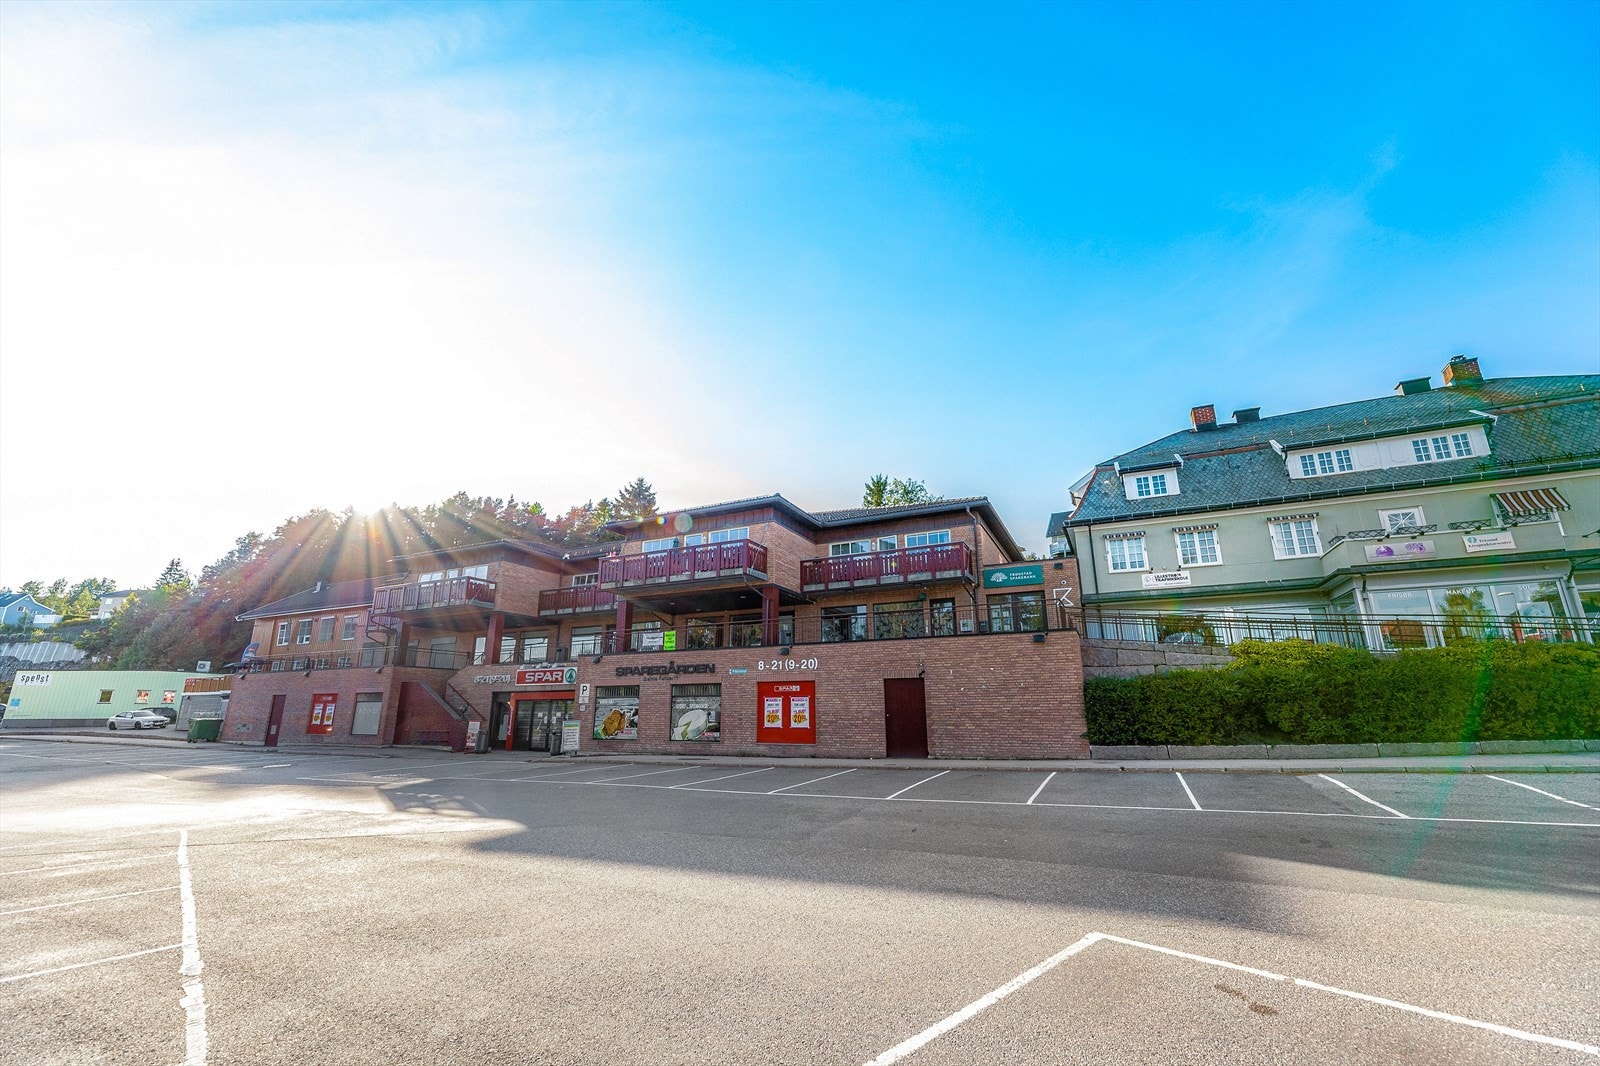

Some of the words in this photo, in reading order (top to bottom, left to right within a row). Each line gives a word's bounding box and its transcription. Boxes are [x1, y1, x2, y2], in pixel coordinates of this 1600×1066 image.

[615, 661, 715, 676] SPAREGÅRDEN
[525, 671, 563, 683] SPAR
[581, 685, 588, 695] P
